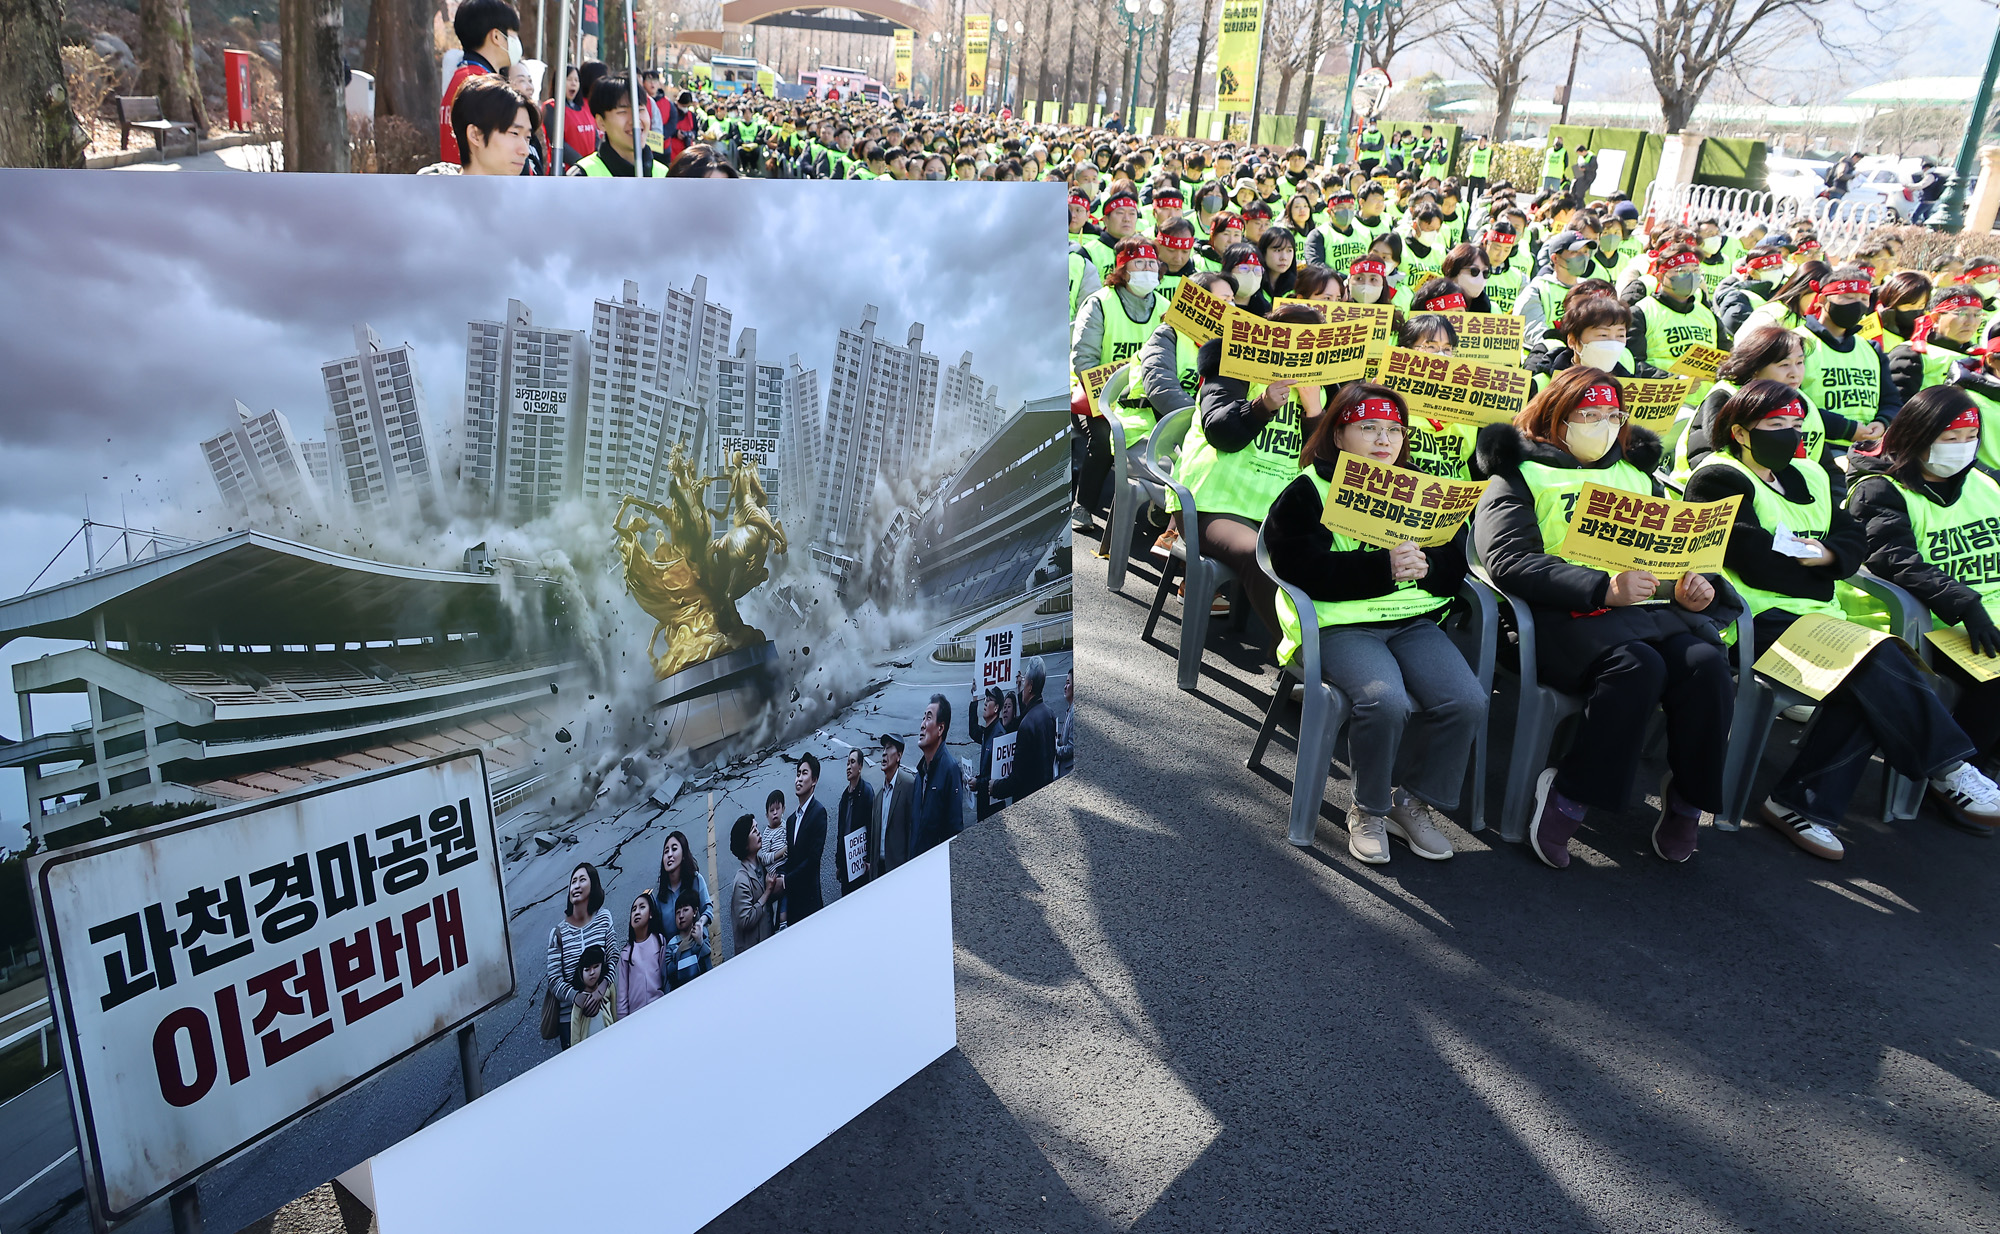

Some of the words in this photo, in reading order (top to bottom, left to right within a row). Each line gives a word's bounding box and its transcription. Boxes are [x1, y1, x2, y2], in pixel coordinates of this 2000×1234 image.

[1231, 319, 1292, 350] 말산업
[1296, 323, 1368, 350] 숨통끊는
[1663, 325, 1714, 345] 경마공원
[1227, 343, 1312, 368] 과천경마공원
[1315, 344, 1366, 365] 이전반대
[1388, 351, 1450, 382] 말산업
[1452, 363, 1526, 395] 숨통끊는
[1382, 374, 1468, 403] 과천경마공원
[1469, 390, 1523, 413] 이전반대
[1820, 367, 1878, 388] 경마공원
[1343, 459, 1419, 503] 말산업
[1335, 487, 1438, 530] 과천경마공원
[1586, 489, 1671, 531] 말산업
[1671, 502, 1734, 534] 숨통끊는
[1577, 516, 1689, 555] 과천경마공원
[984, 630, 1014, 659] 개발
[983, 658, 1012, 687] 반대
[88, 797, 478, 1012] 과천경마공원
[152, 887, 469, 1108] 이전반대
